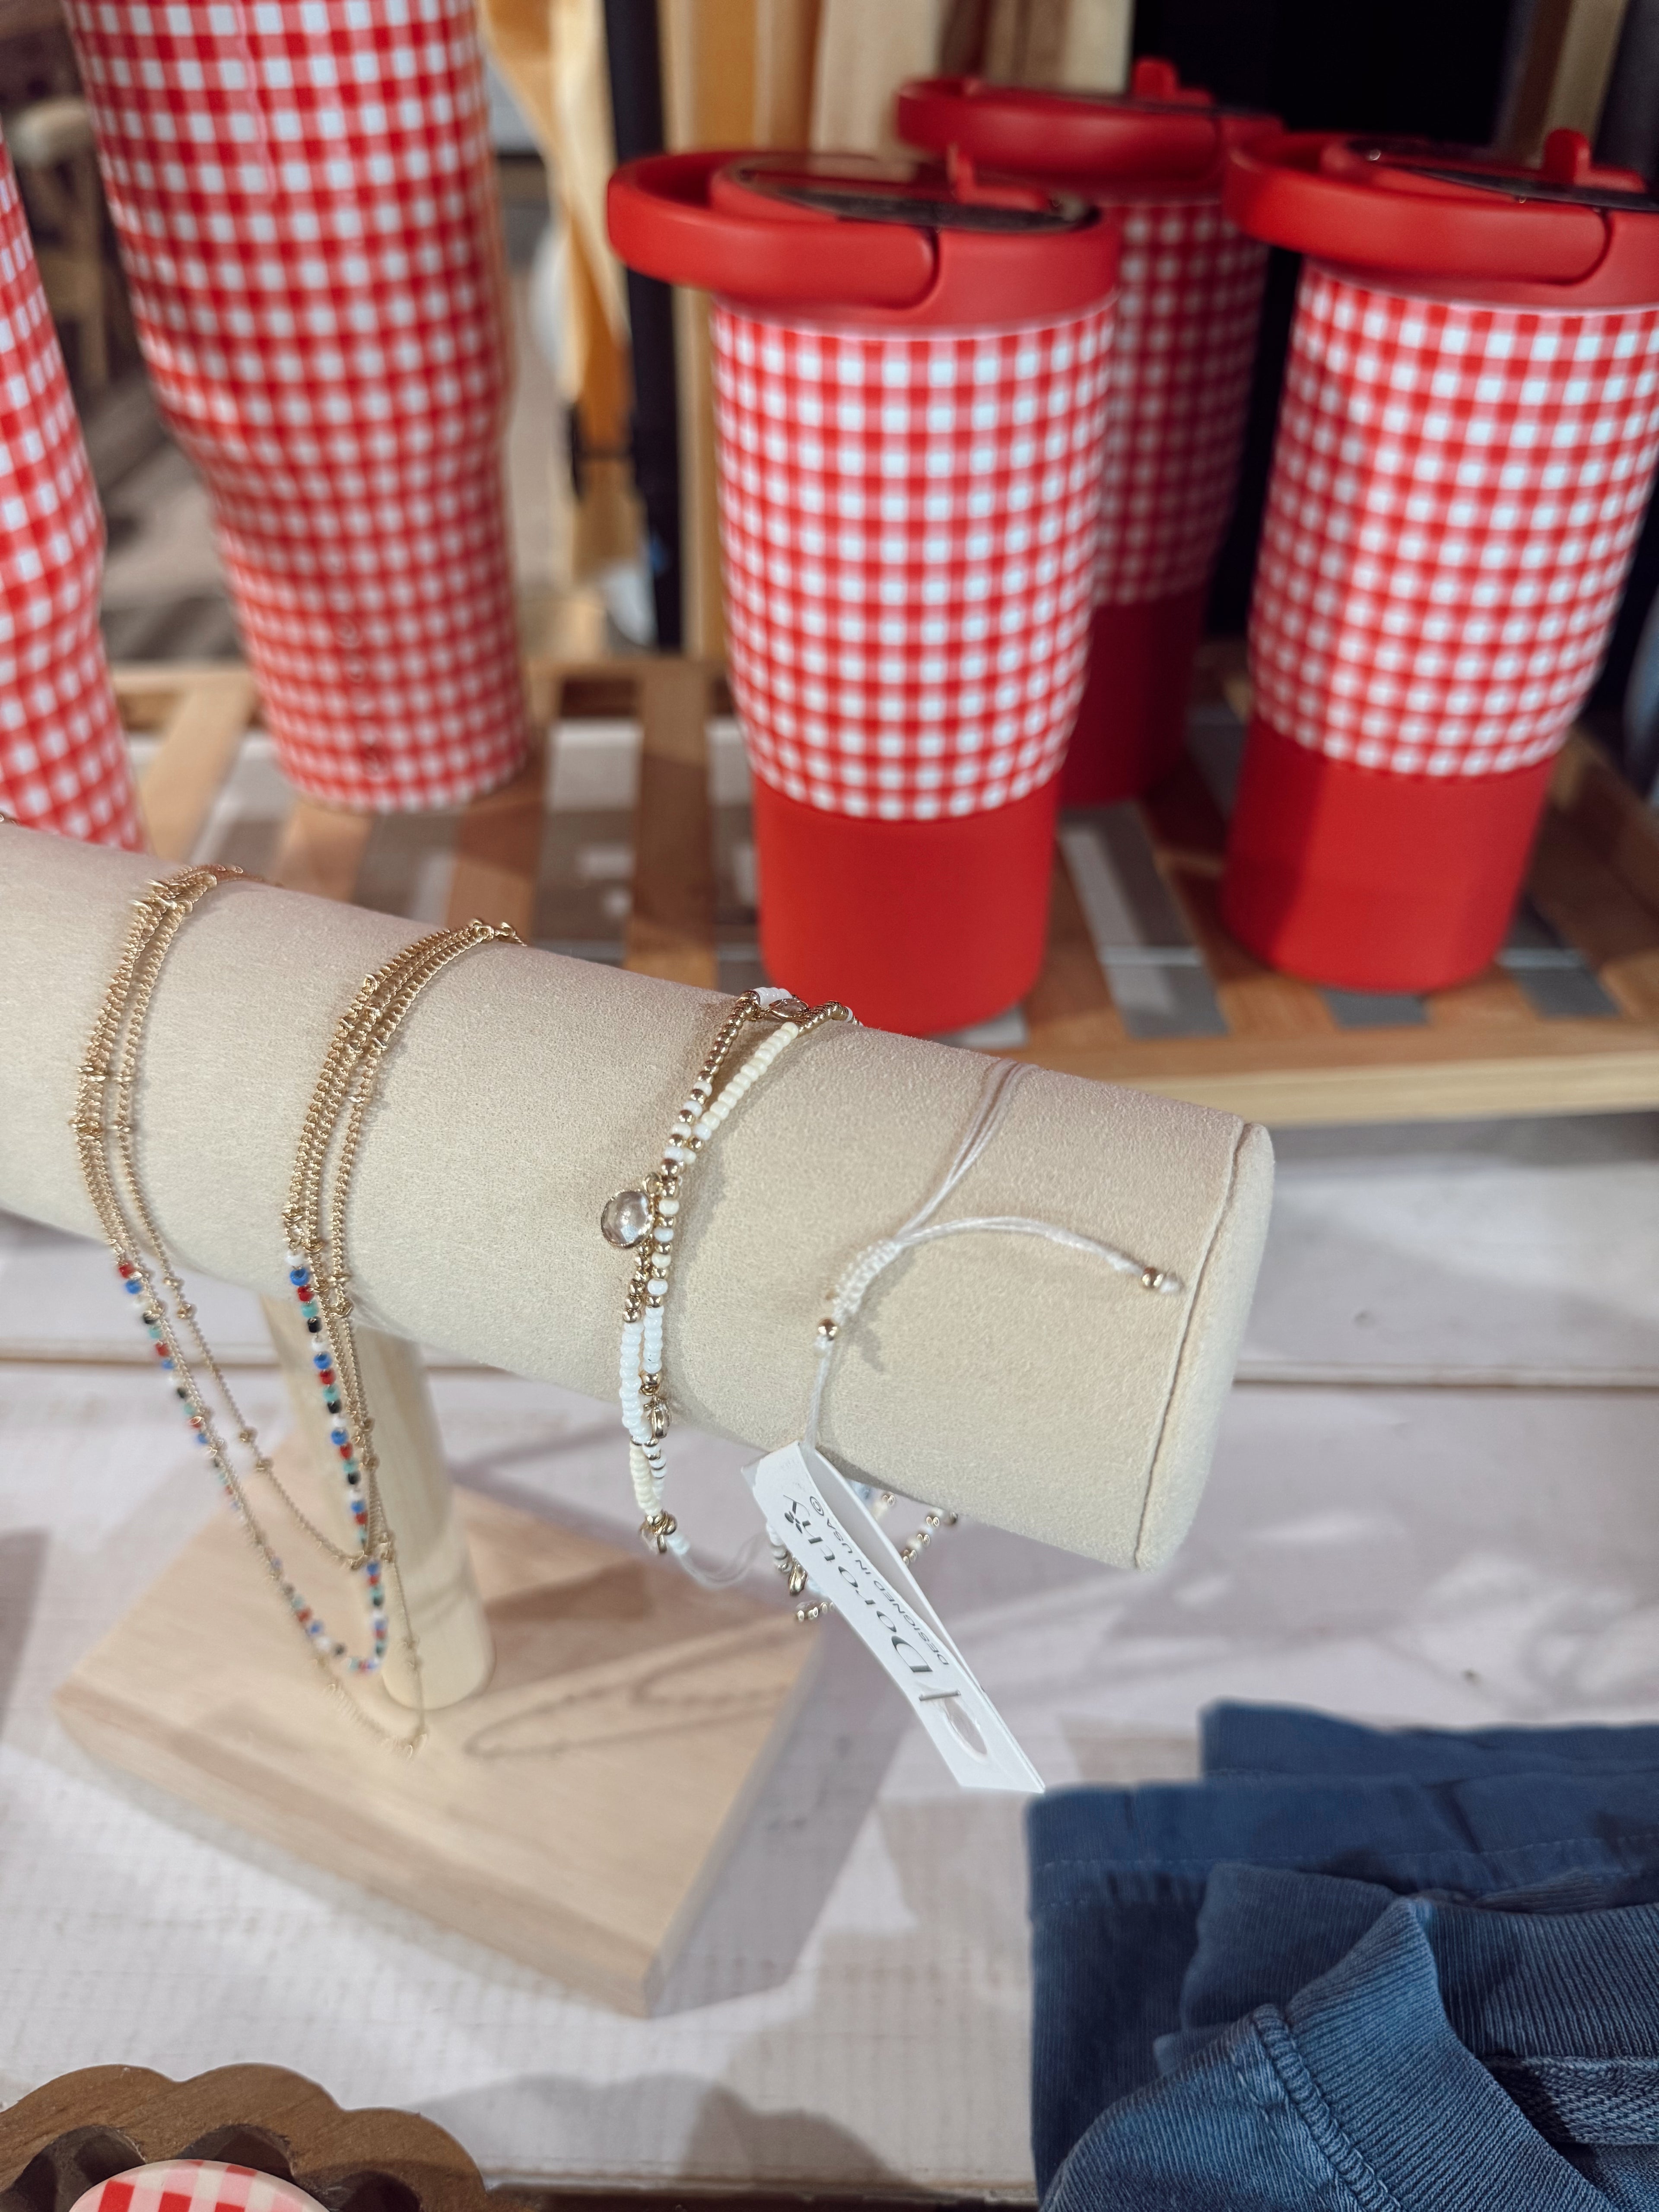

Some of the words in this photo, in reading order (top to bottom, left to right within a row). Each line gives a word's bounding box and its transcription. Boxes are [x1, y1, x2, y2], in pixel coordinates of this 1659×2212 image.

[783, 1494, 933, 1673] Dorothy
[855, 1560, 871, 1574] IN
[873, 1580, 950, 1665] DESIGNED
